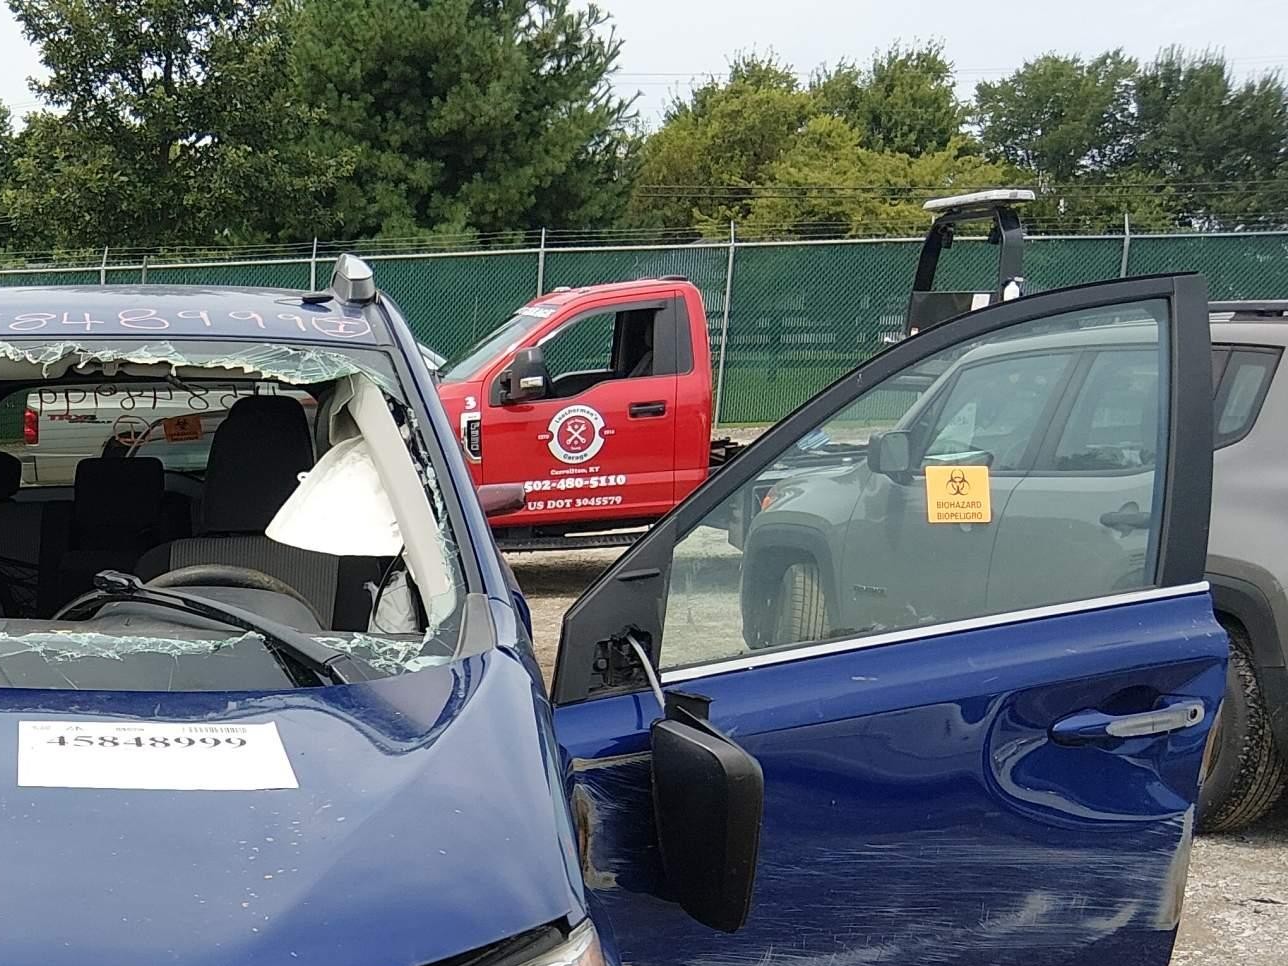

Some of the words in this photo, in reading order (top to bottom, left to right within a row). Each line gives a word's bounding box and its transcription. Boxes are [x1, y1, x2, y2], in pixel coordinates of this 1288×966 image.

[464, 396, 477, 410] 3
[524, 474, 626, 493] 502-480-5110
[527, 501, 544, 511] US
[546, 499, 572, 509] DOT
[575, 495, 622, 507] 3045579
[936, 501, 982, 510] BIOHAZARD
[937, 511, 983, 520] BIOPELIGRO
[47, 735, 247, 749] 45848999
